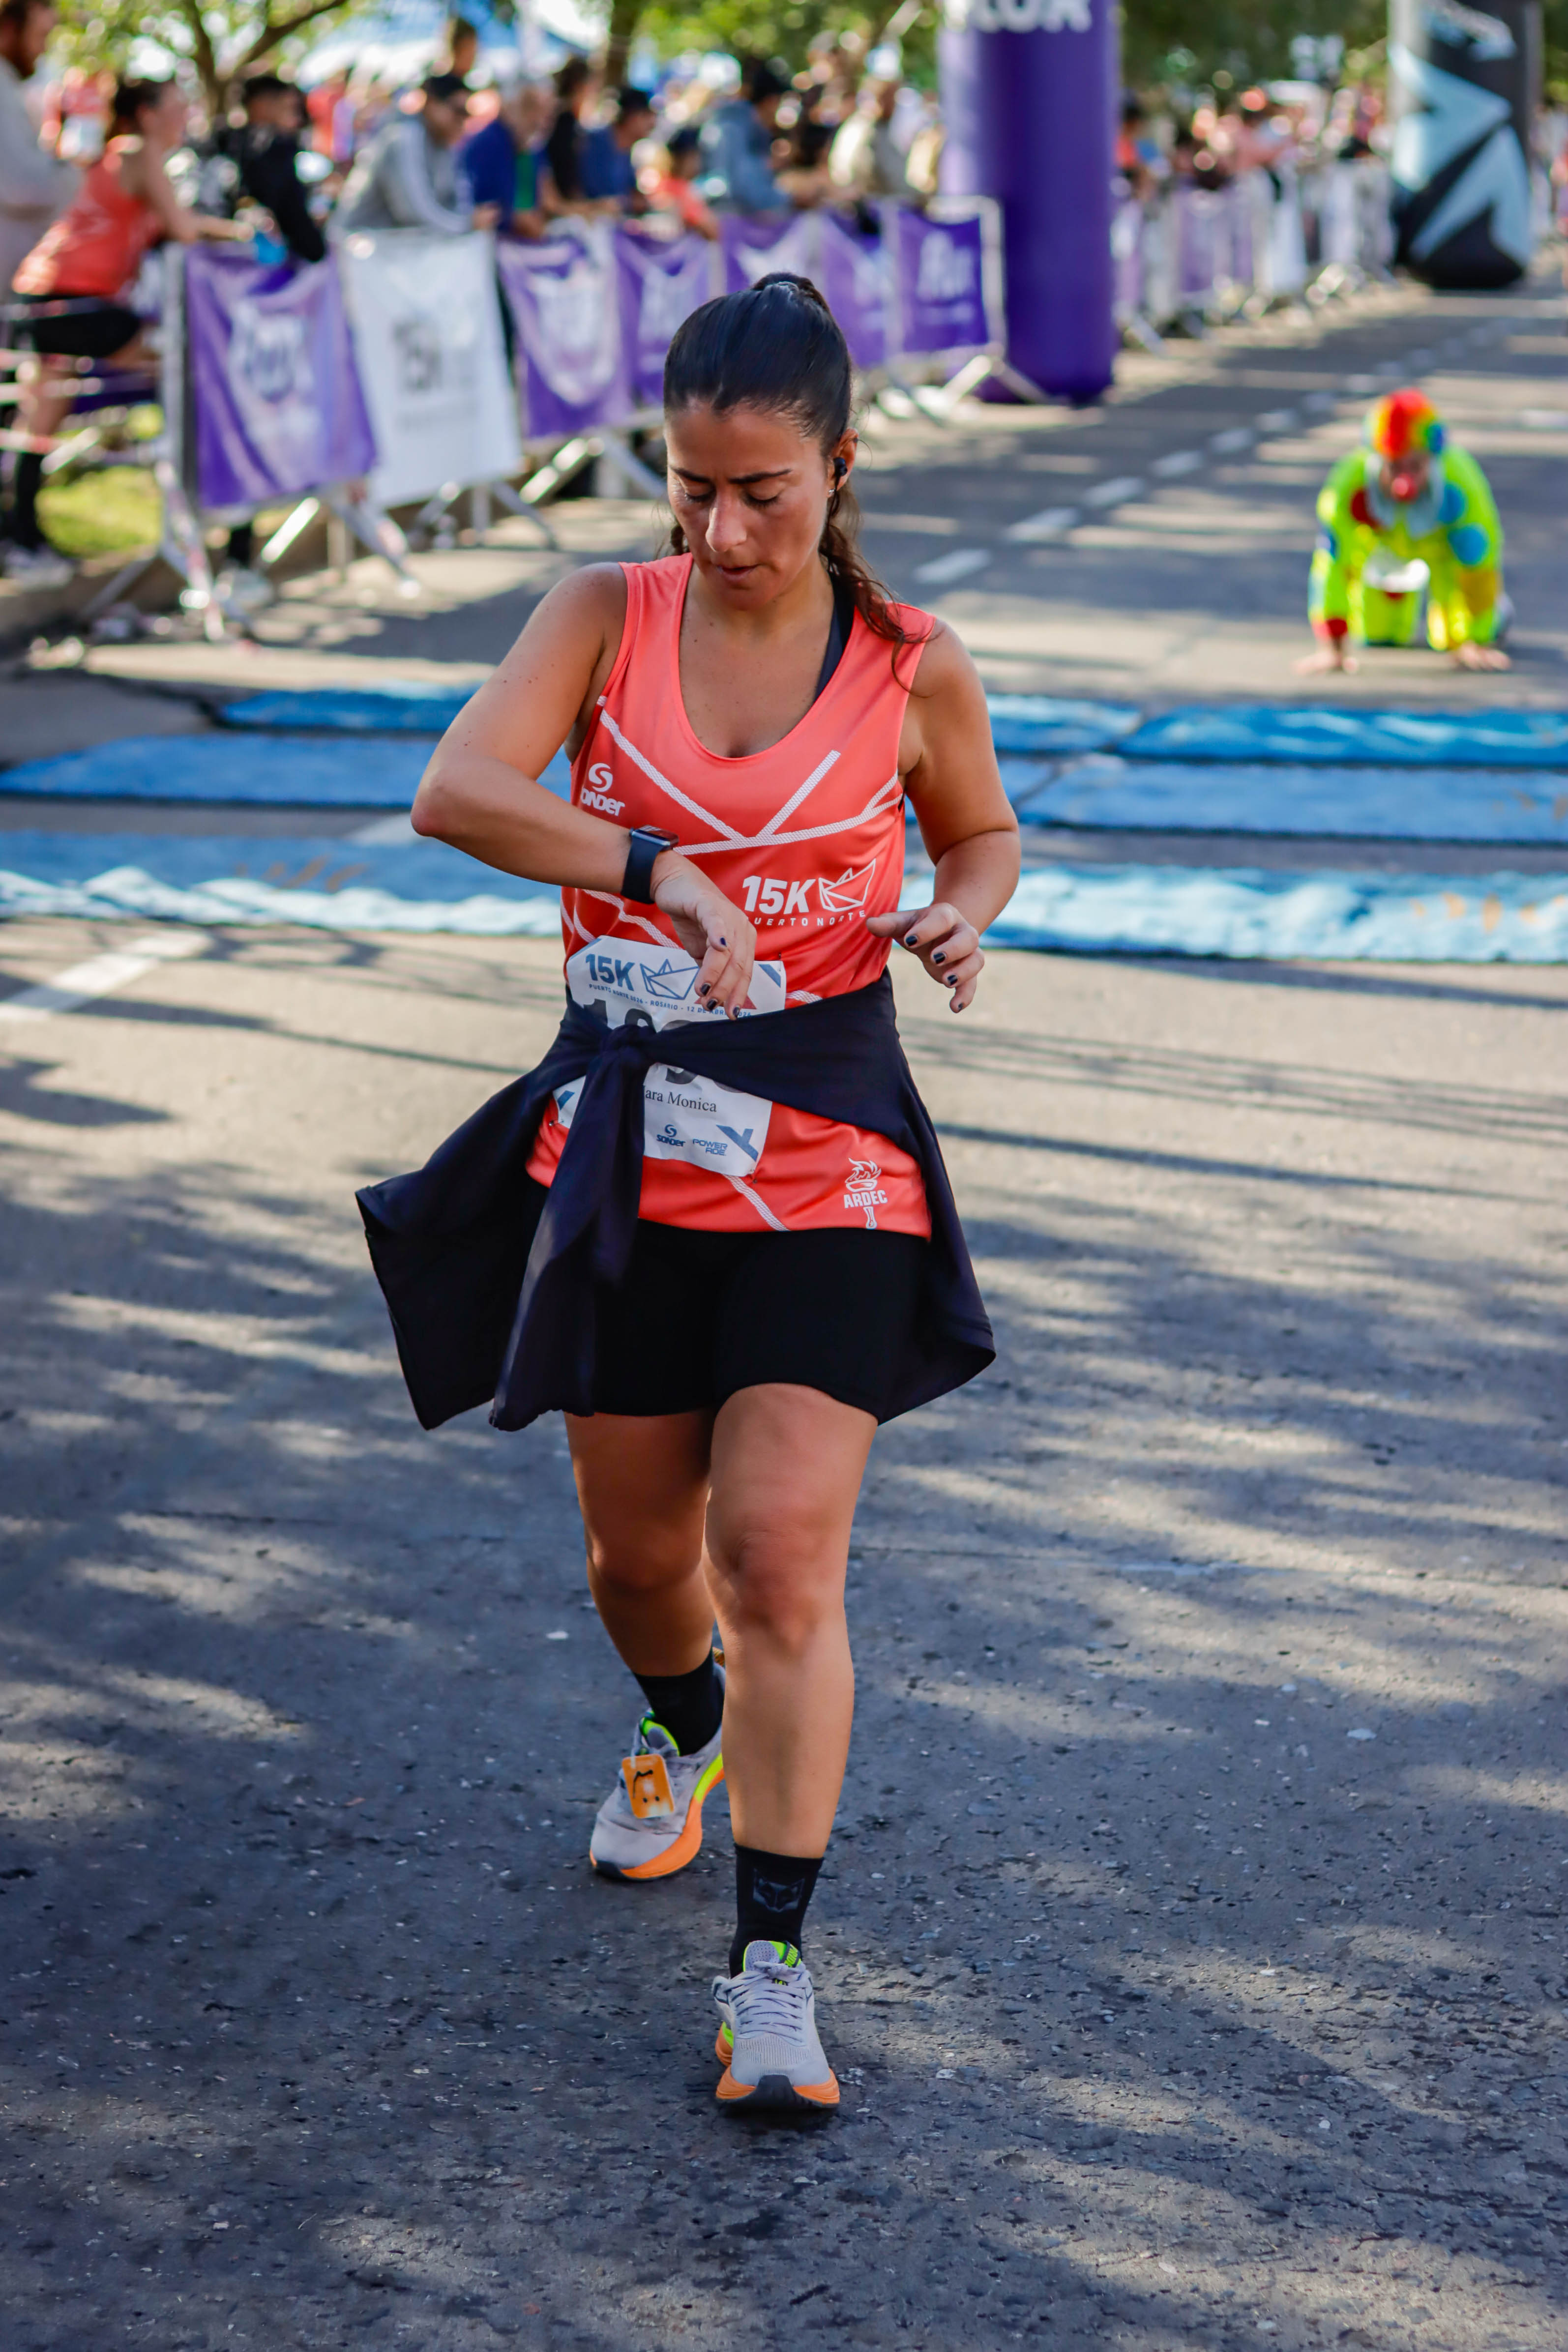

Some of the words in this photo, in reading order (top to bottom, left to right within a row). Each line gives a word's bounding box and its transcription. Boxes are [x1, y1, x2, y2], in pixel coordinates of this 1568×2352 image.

[742, 875, 816, 914] 15K
[754, 917, 808, 927] UERTO
[817, 910, 866, 926] NORTE
[586, 953, 635, 991] 15K
[589, 984, 611, 993] PUERTO
[613, 989, 629, 999] NORTE
[650, 1000, 678, 1010] ROSARIO
[645, 1089, 663, 1102] ara
[668, 1091, 717, 1112] Monica
[692, 1139, 728, 1150] POWER
[844, 1190, 888, 1208] ARDEC
